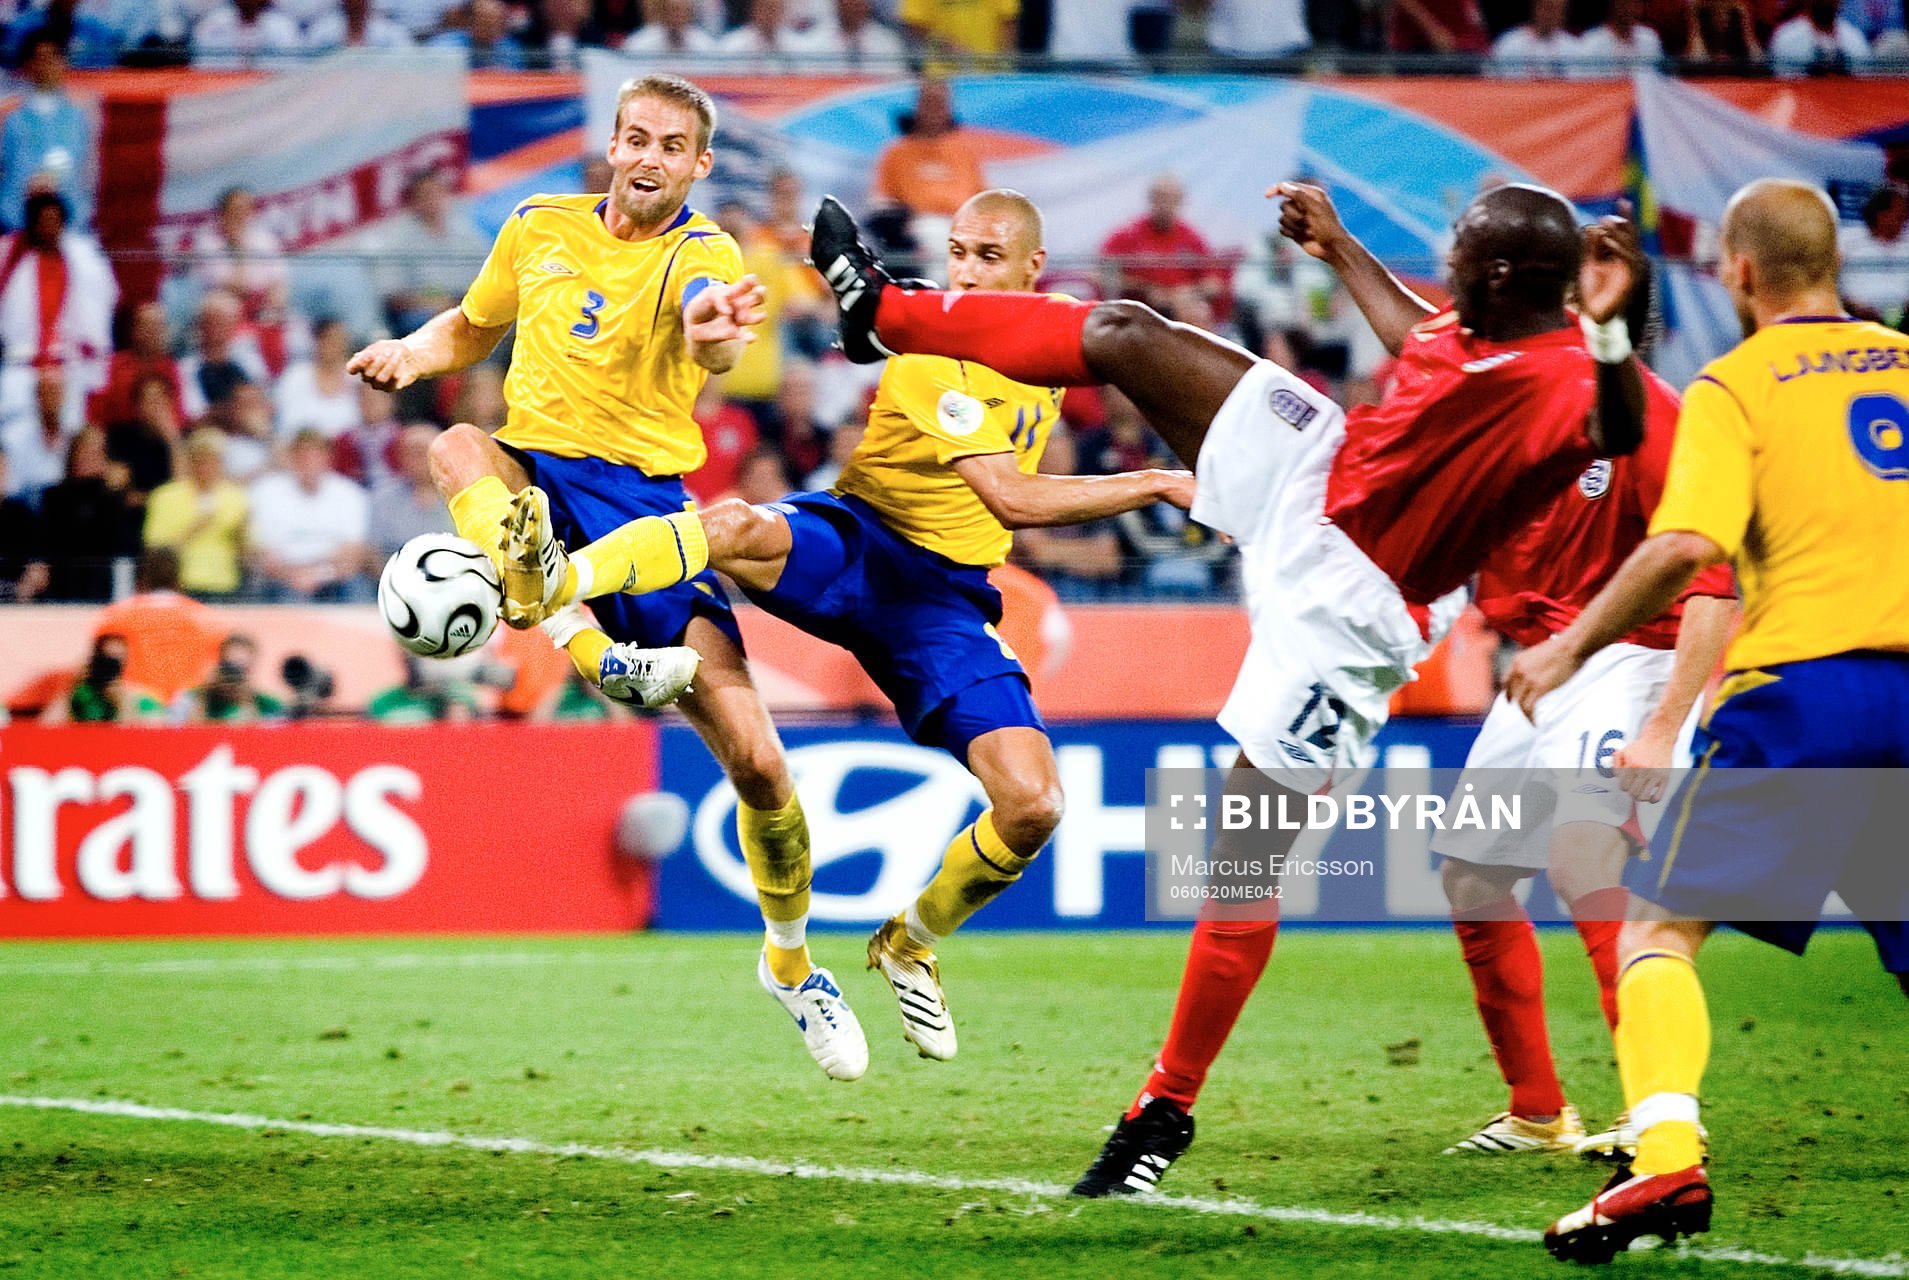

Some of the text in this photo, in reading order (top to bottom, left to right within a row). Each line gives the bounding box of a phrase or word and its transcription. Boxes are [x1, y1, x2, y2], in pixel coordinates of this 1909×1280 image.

[569, 288, 605, 340] 3
[1768, 345, 1909, 382] LJUNGBE
[1845, 391, 1909, 480] 9
[1288, 681, 1344, 750] 12
[1576, 728, 1624, 779] 16
[0, 742, 429, 901] rates
